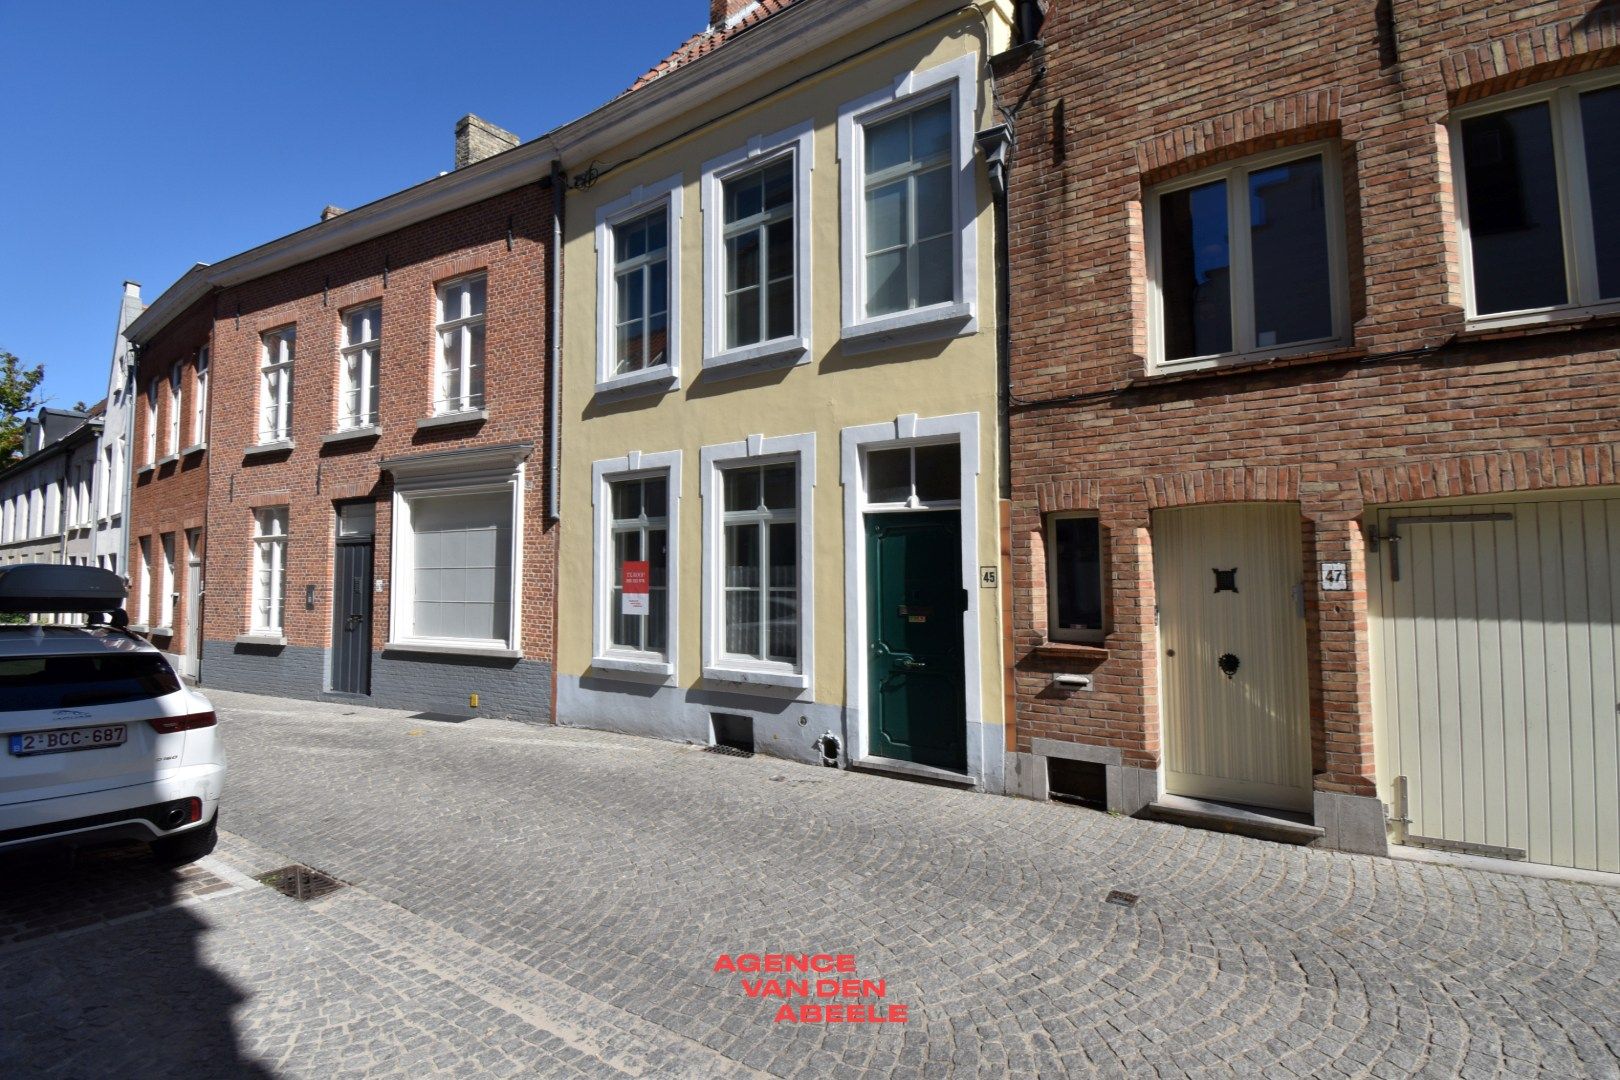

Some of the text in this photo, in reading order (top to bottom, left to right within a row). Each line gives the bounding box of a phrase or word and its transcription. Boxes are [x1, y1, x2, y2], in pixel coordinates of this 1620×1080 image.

[983, 571, 995, 583] 45
[1326, 569, 1342, 583] 47
[24, 727, 124, 750] 2-BCC-687
